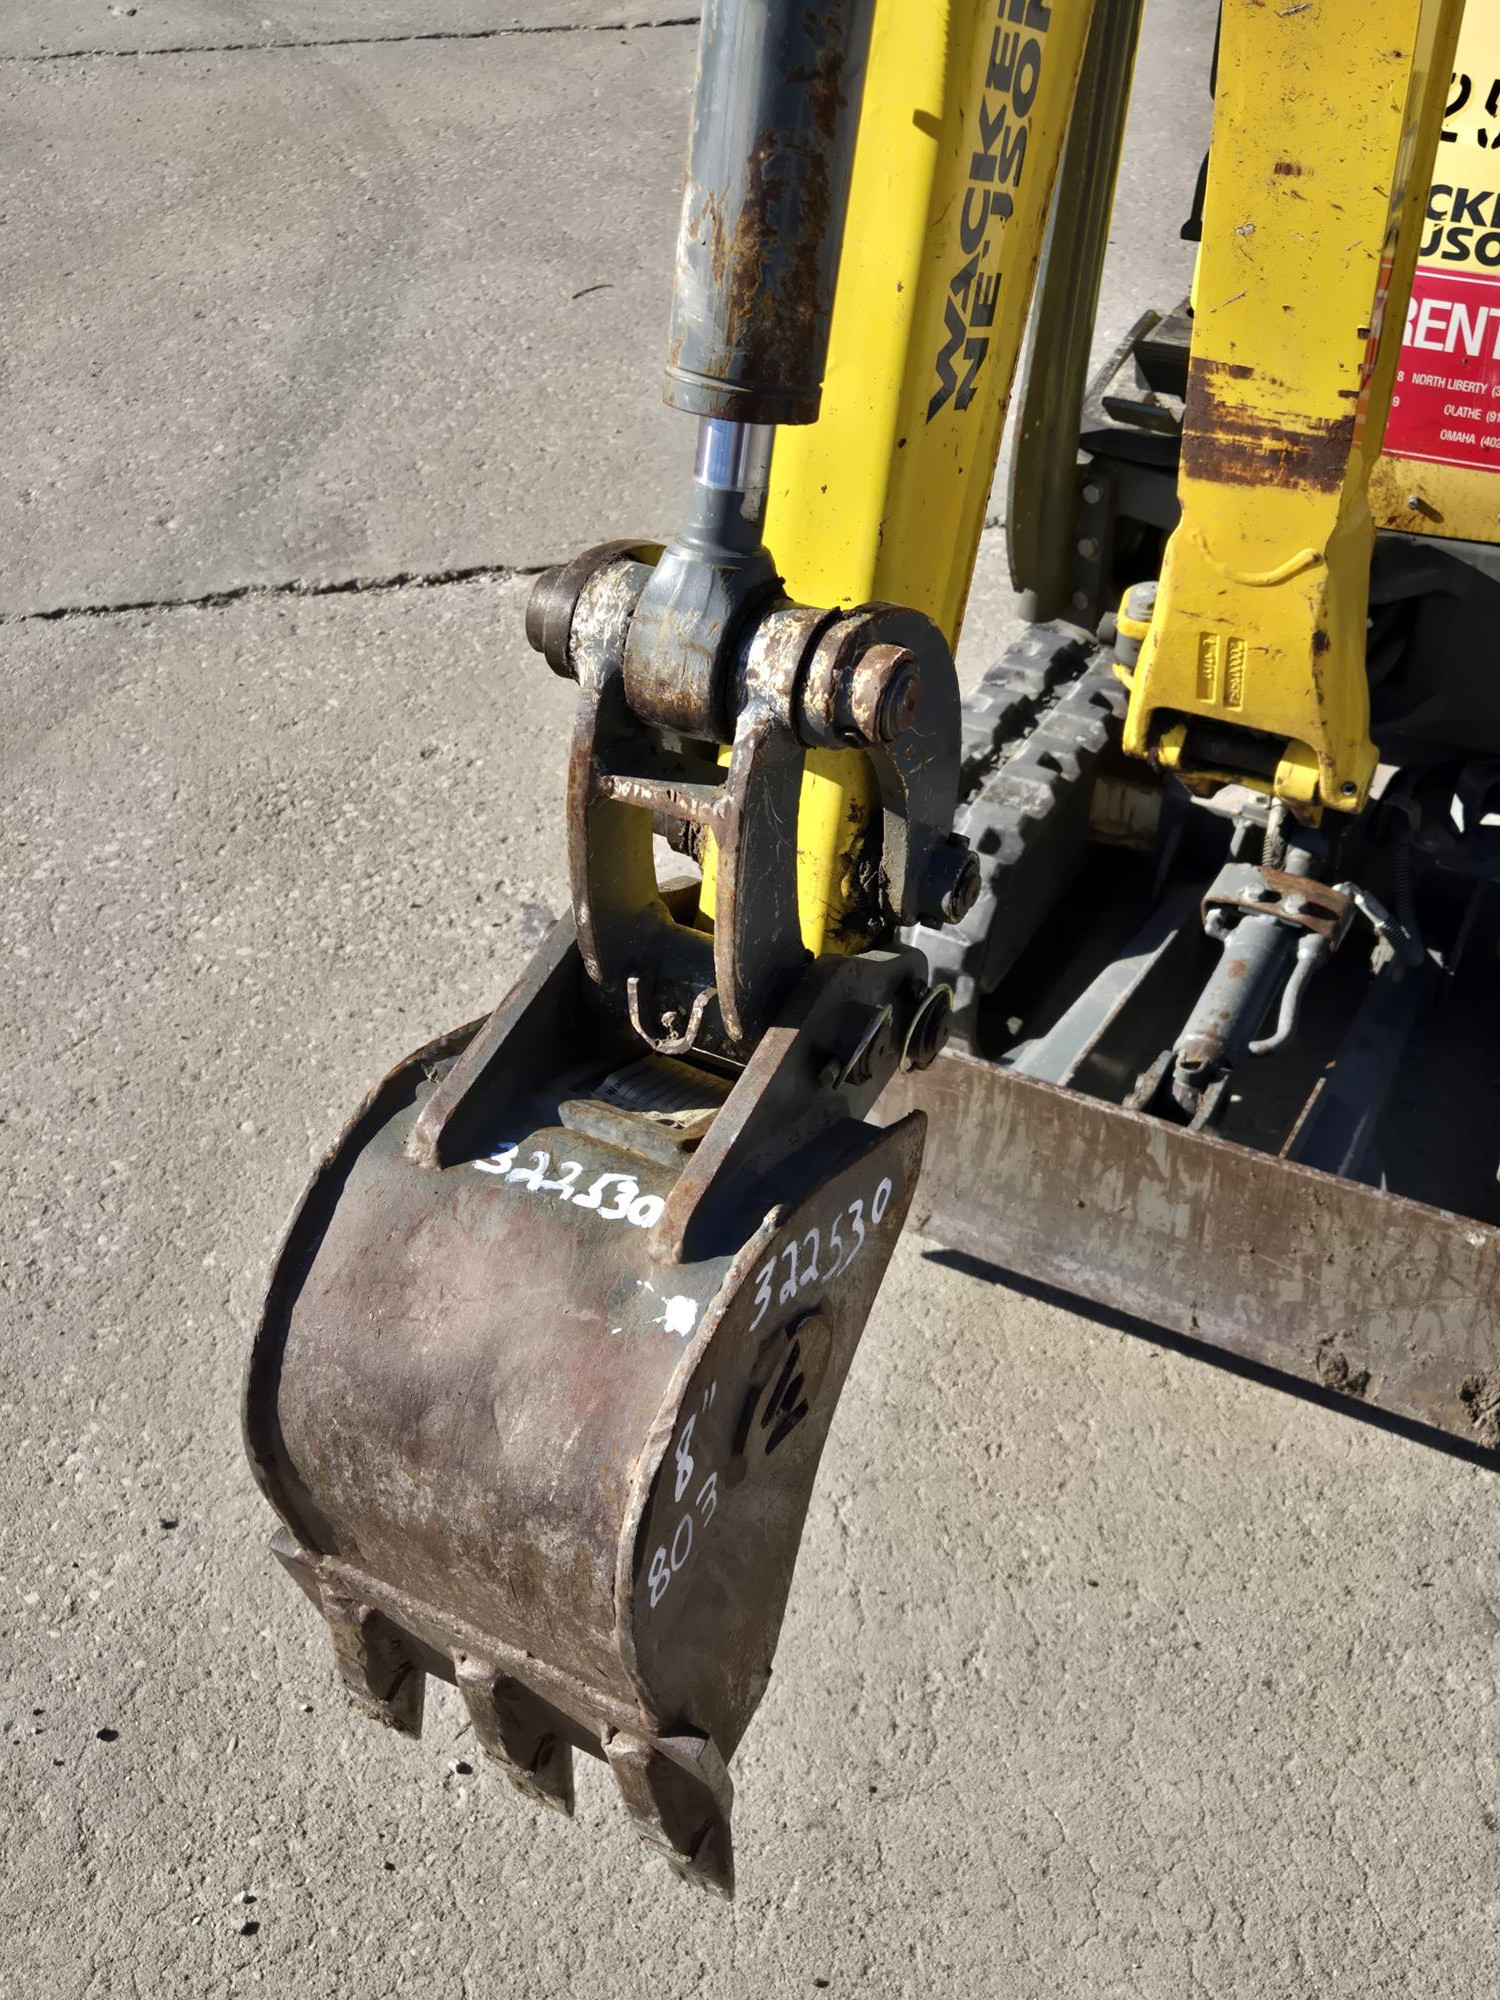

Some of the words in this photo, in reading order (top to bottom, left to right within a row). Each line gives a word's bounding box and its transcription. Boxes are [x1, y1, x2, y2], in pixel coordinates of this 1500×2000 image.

[1412, 372, 1447, 389] NORTH
[1446, 378, 1489, 395] LIBERTY
[1440, 428, 1476, 445] OMAHA
[471, 1142, 666, 1229] 322530
[749, 1176, 892, 1333] 322530
[648, 1471, 717, 1609] 803
